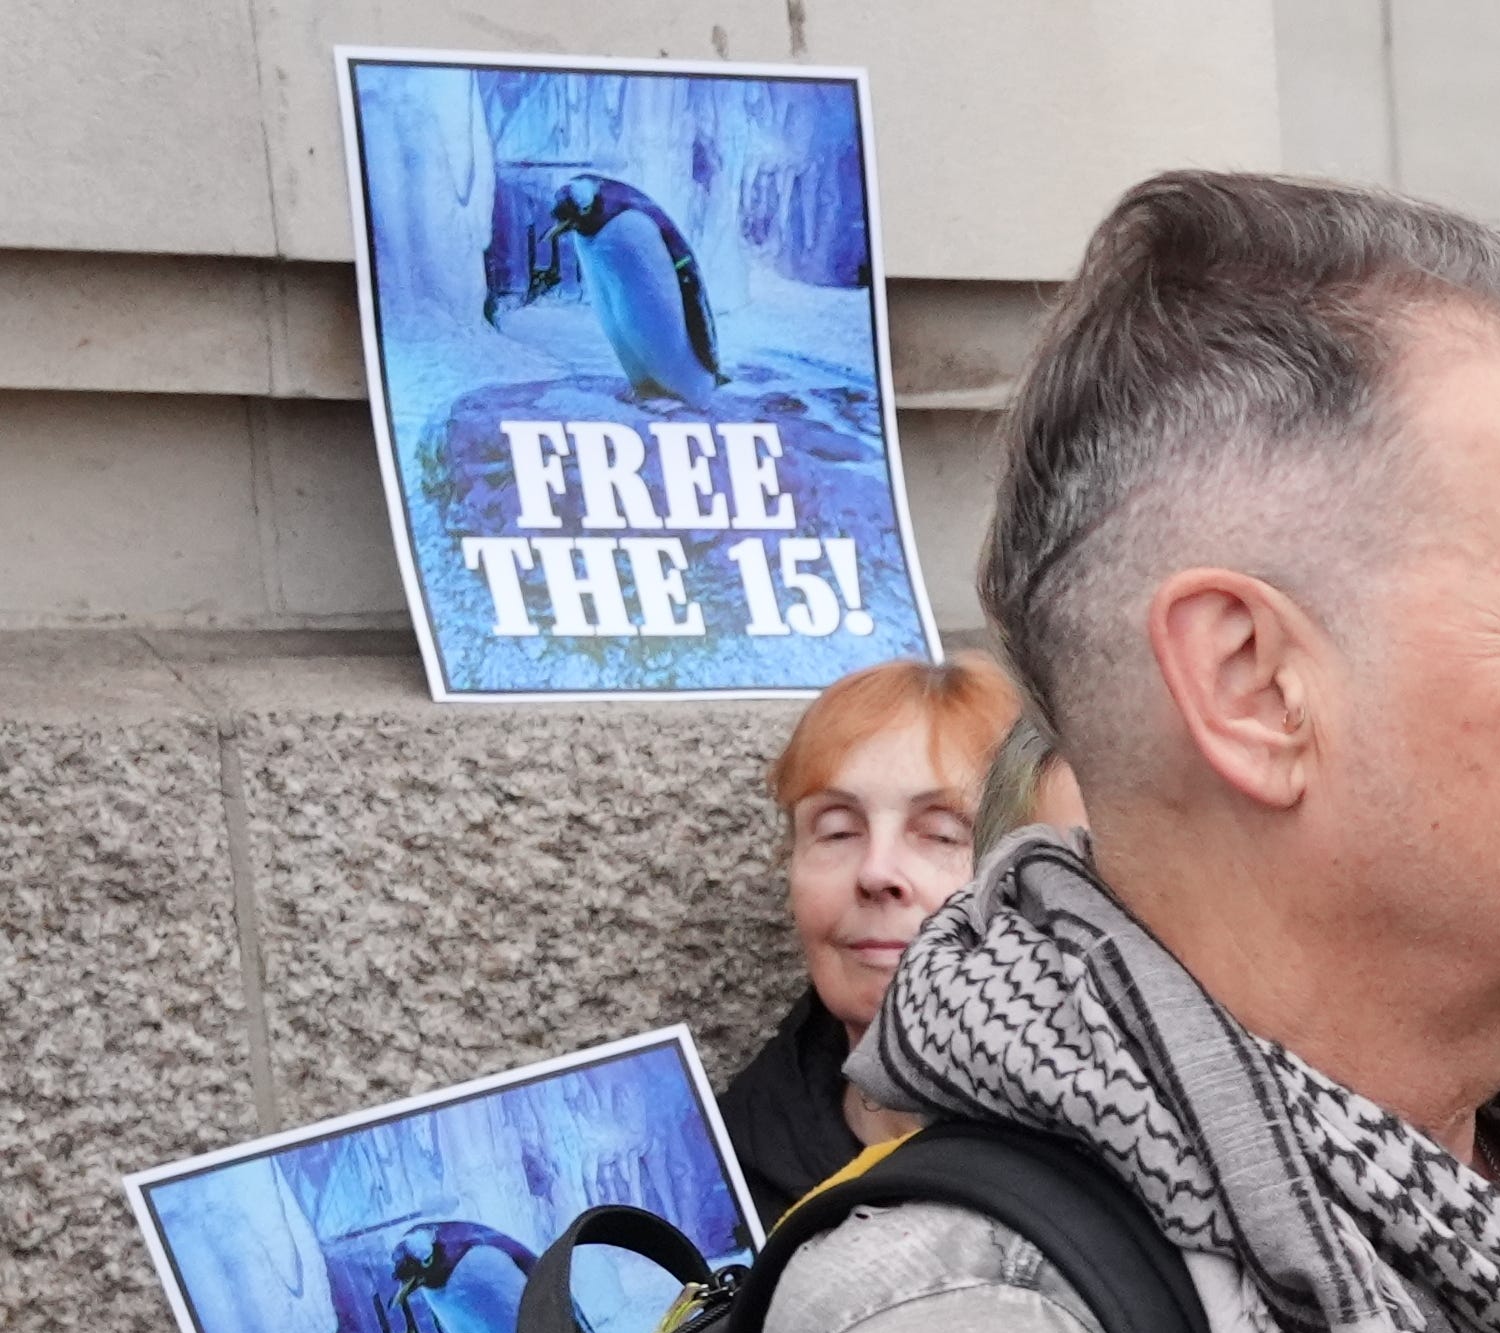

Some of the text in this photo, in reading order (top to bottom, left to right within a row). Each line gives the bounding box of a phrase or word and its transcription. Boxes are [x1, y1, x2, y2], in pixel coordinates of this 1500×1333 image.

[502, 420, 797, 530] FREE
[460, 536, 875, 637] THE 15!
